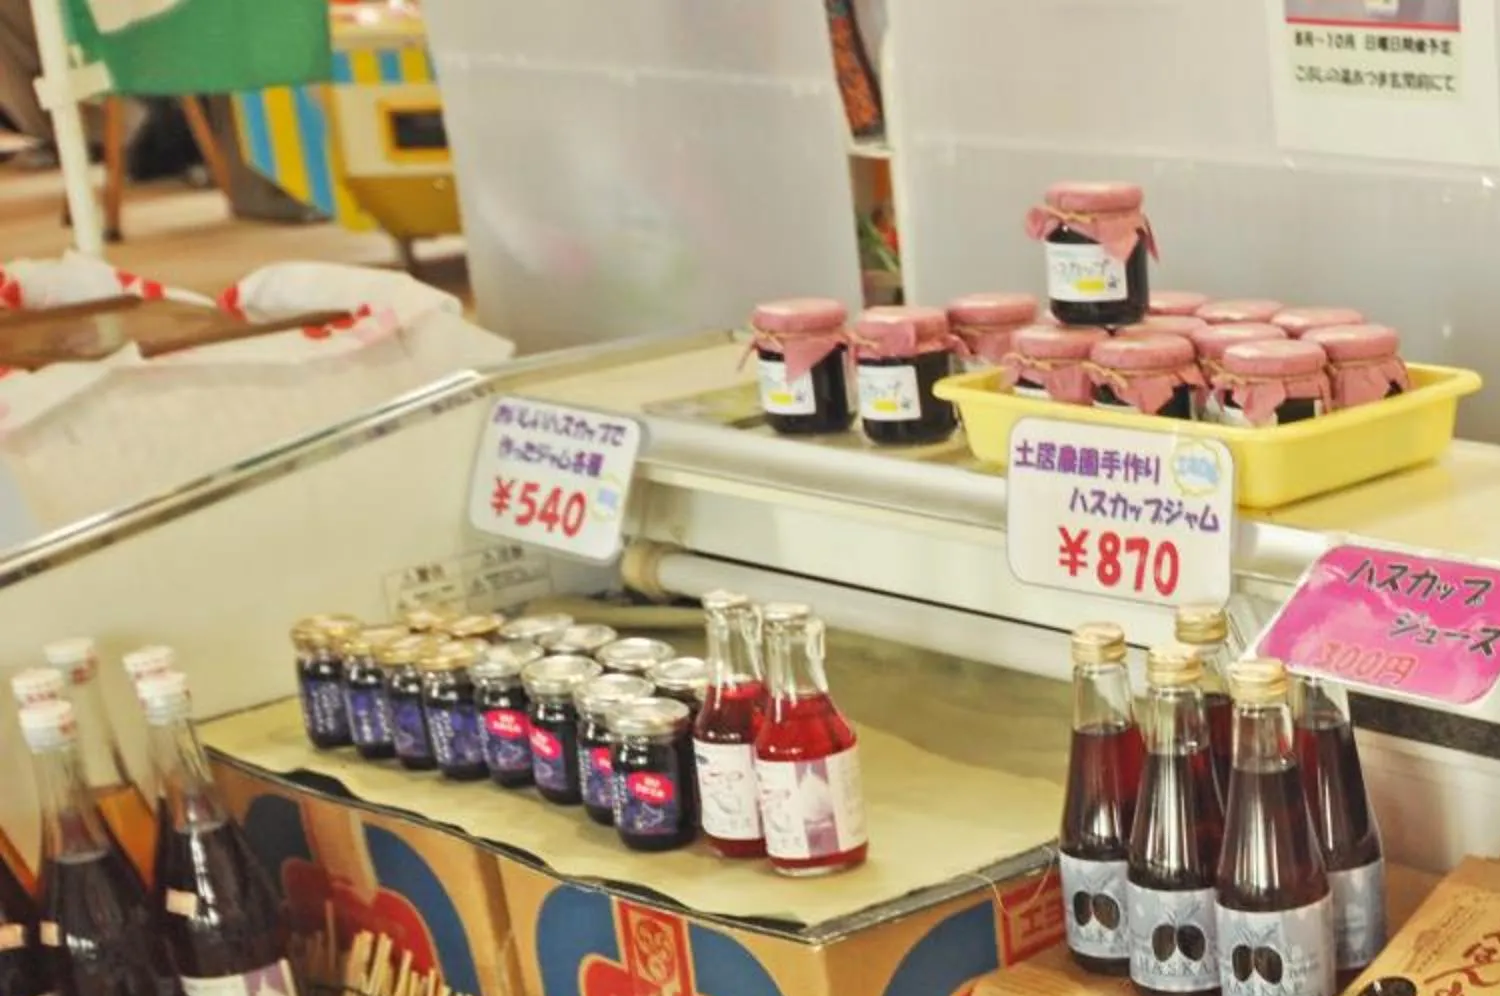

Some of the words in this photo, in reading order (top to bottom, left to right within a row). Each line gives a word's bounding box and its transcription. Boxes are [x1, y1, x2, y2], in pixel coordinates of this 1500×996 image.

[491, 475, 587, 538] ¥540
[1068, 487, 1222, 533] ハスカップジャム
[1058, 525, 1180, 597] ¥870
[1346, 559, 1493, 606] ハスカップ
